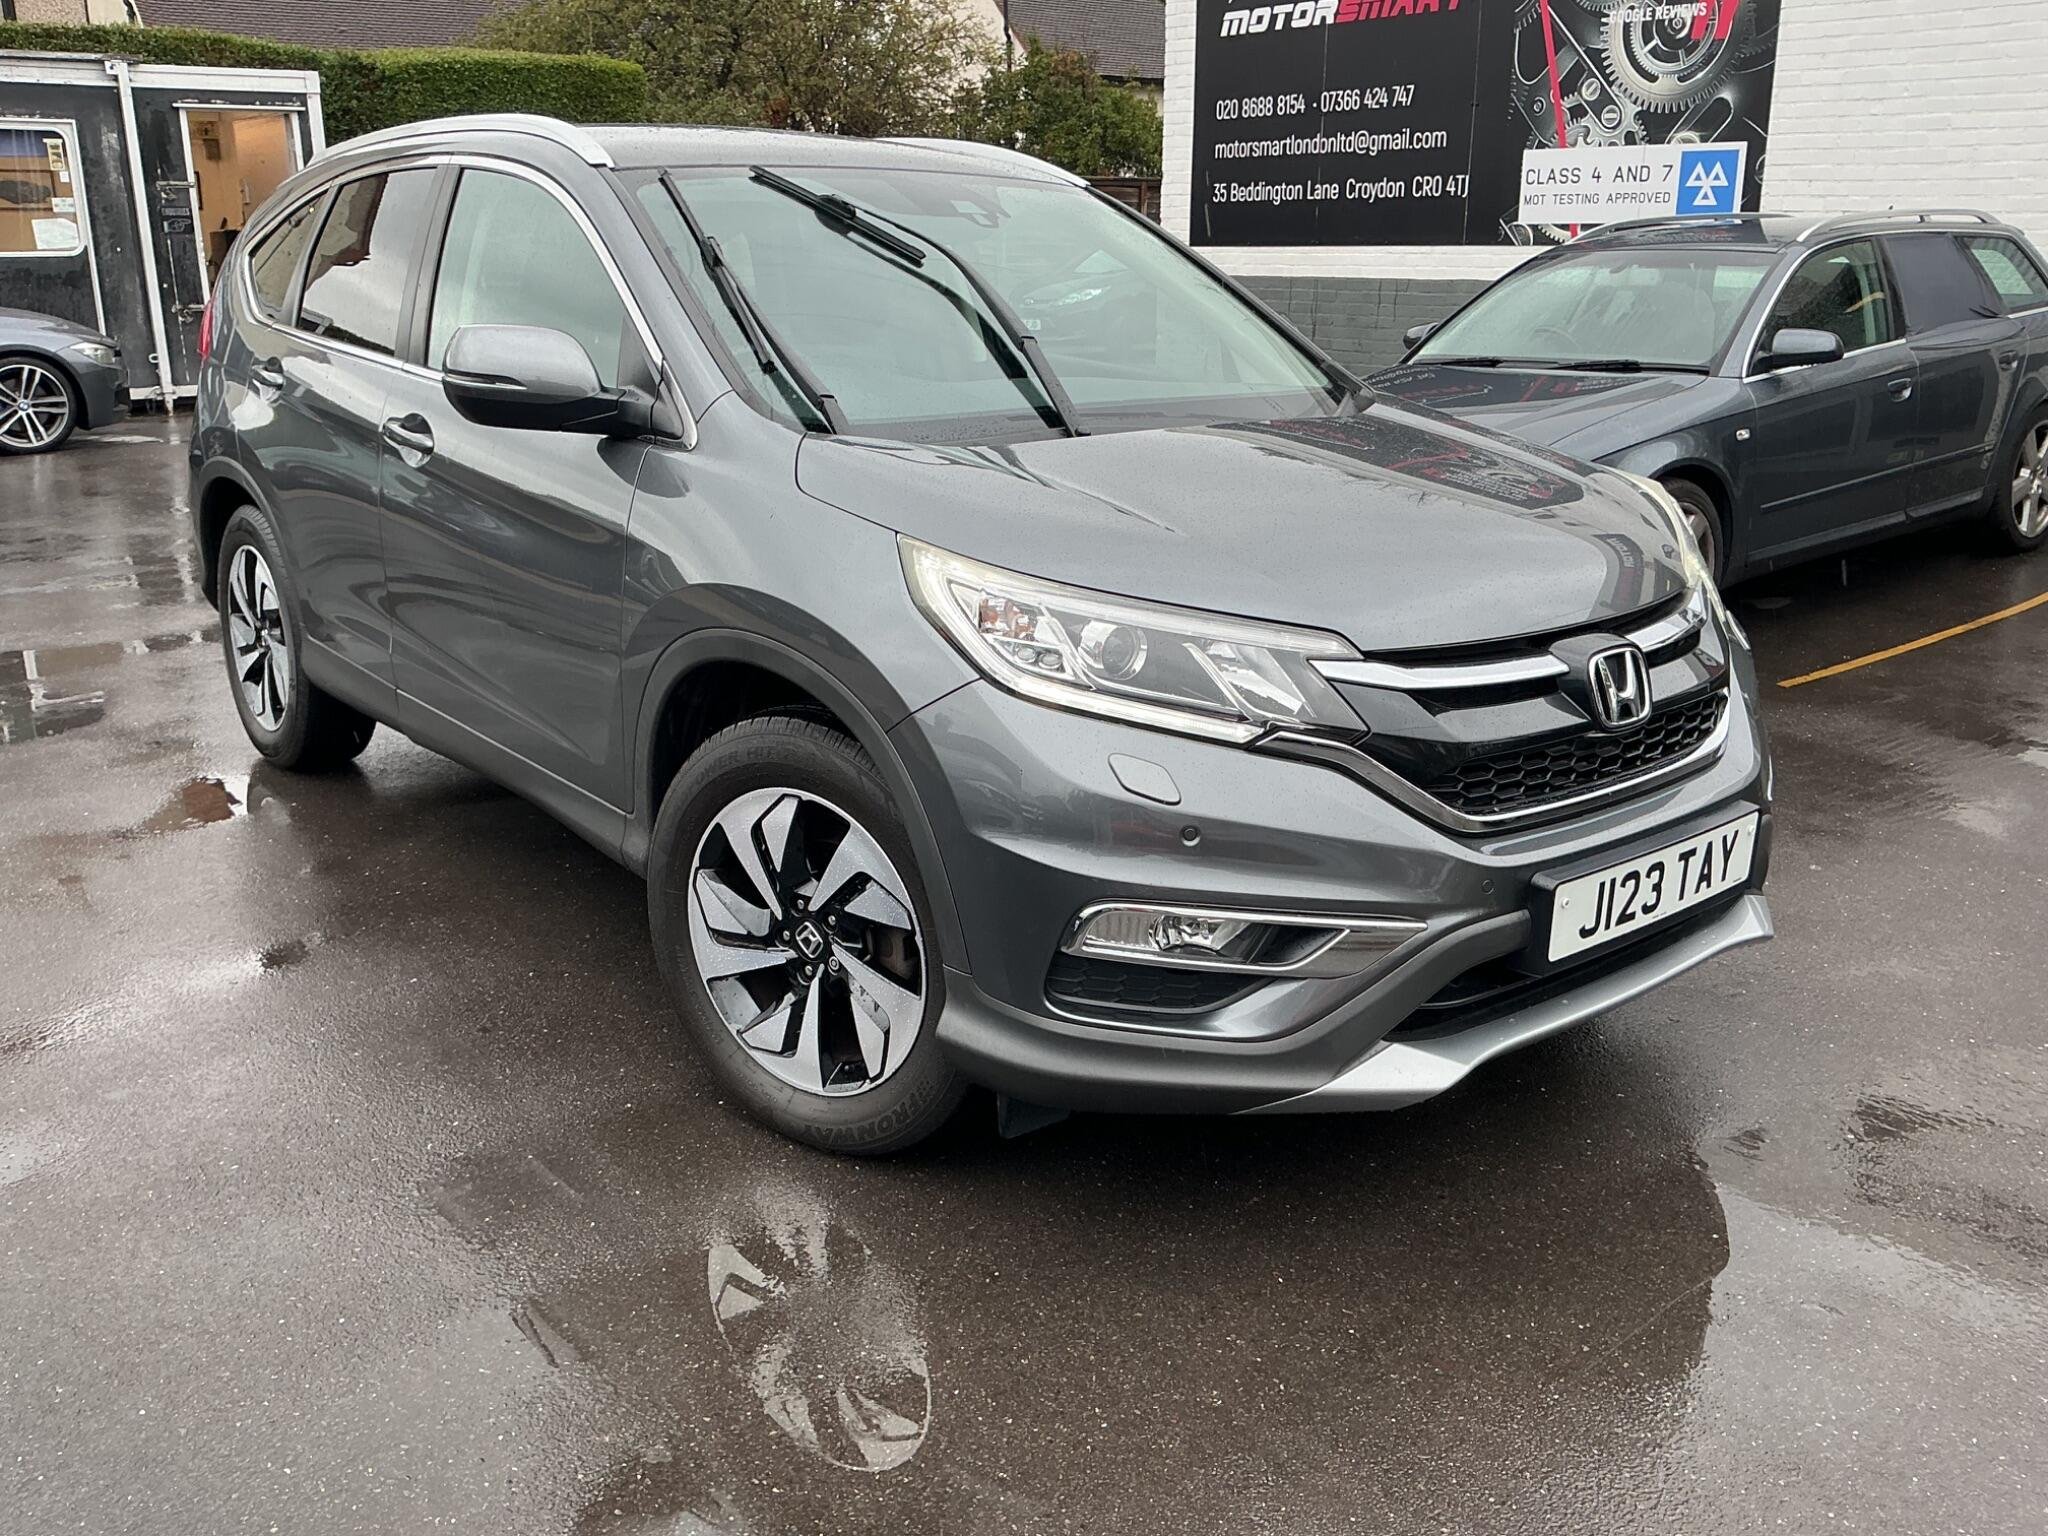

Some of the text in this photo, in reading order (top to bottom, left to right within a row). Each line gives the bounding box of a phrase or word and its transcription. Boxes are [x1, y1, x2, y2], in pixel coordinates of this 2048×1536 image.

[1609, 2, 1707, 23] GOOGLE REVIEWS
[1216, 84, 1415, 120] 020 8688 8154 07366 424 747
[1215, 128, 1447, 159] motorsmartlondonltd@gmail.com
[1213, 183, 1227, 202] 35
[1230, 181, 1303, 205] Beddington
[1307, 180, 1339, 200] Lane
[1346, 177, 1405, 203] Croydon
[1446, 174, 1469, 197] 4TJ
[1525, 164, 1673, 185] CLASS 4 AND 7
[1523, 192, 1671, 206] MOT TESTING APPROVED
[1578, 829, 1739, 940] J123 TAY
